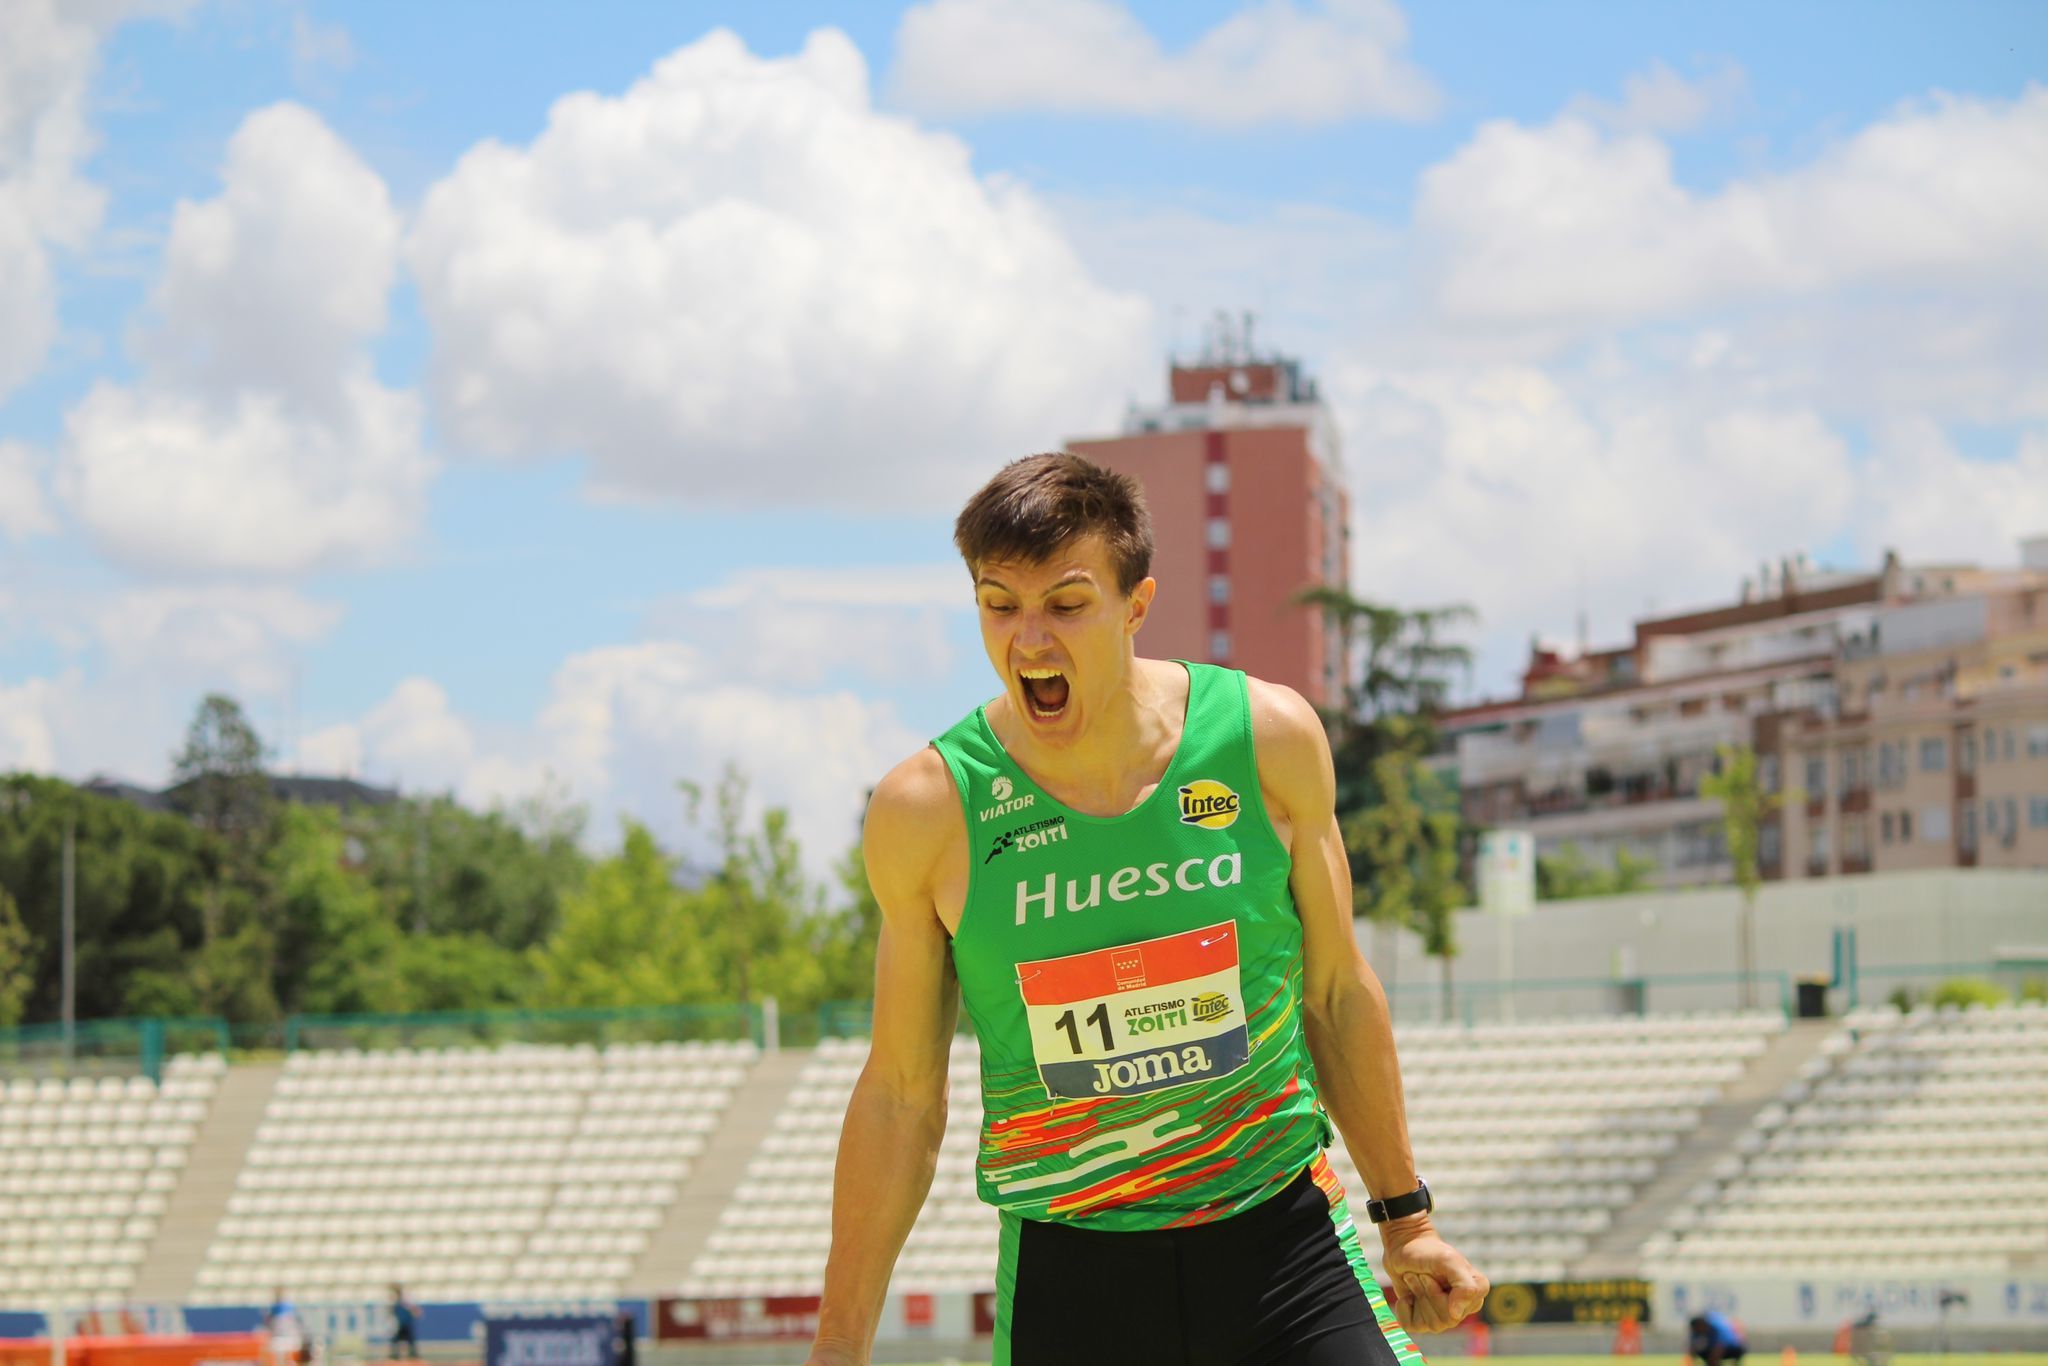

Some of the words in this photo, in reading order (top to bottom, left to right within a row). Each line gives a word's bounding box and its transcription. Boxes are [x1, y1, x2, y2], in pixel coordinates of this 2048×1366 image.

[979, 794, 1035, 822] VIATOR
[1013, 815, 1065, 837] ATLETISMO
[1015, 823, 1068, 852] ZOITI
[1015, 852, 1242, 926] Huesca
[1124, 998, 1186, 1018] ATLETISMO
[1126, 1008, 1188, 1036] ZOITI
[1055, 1003, 1116, 1056] 11
